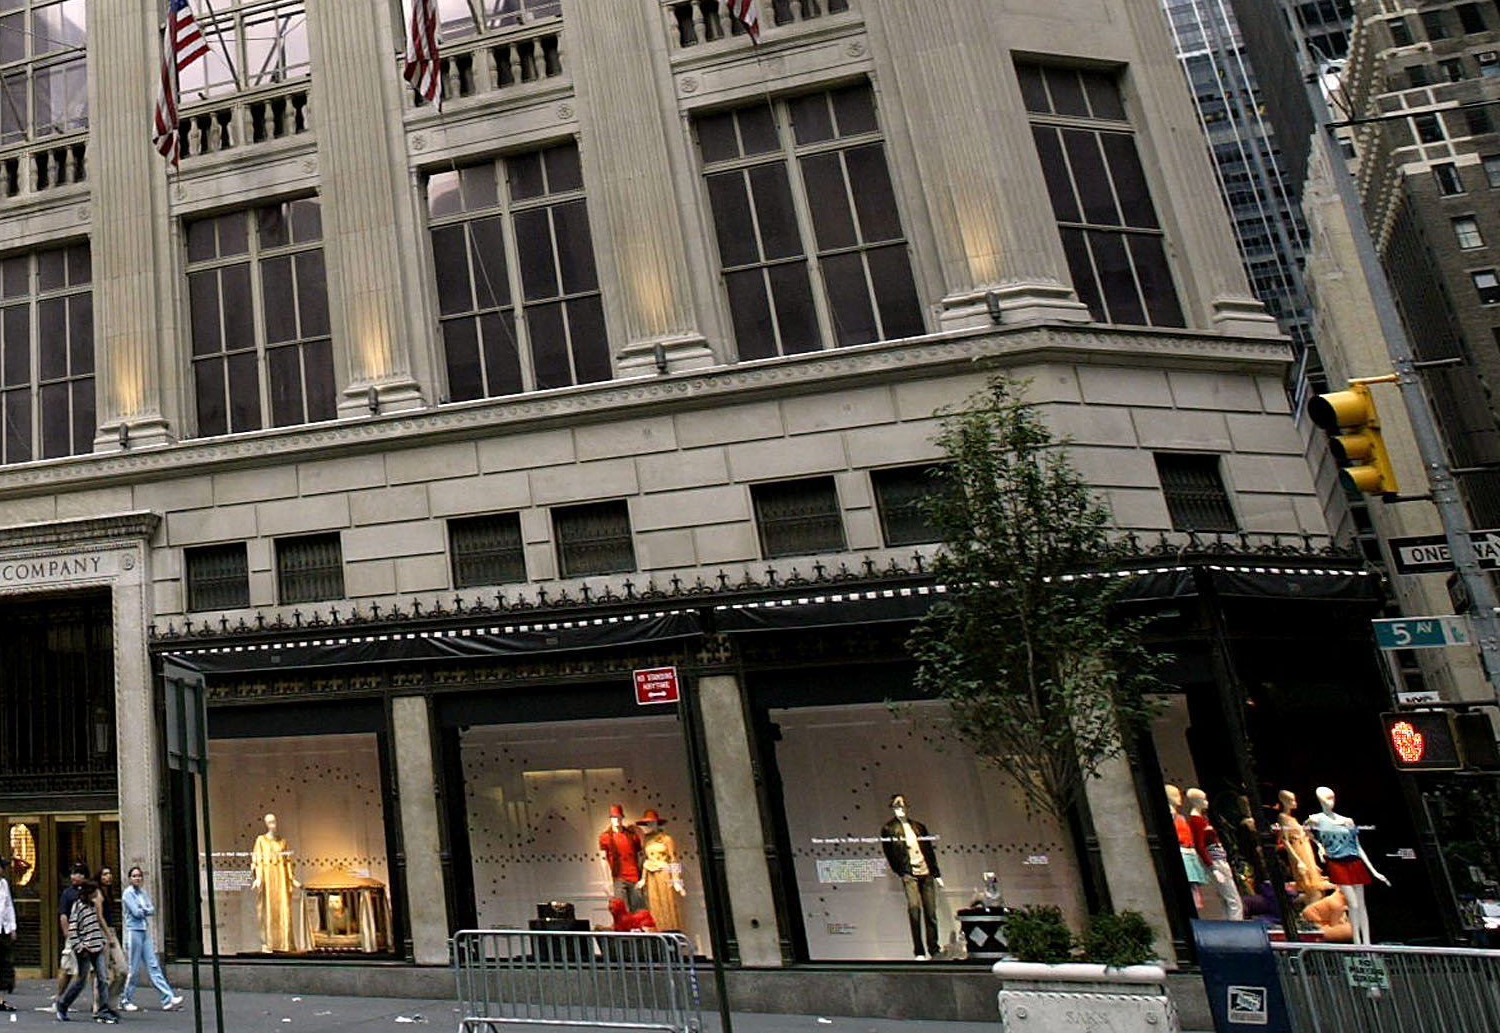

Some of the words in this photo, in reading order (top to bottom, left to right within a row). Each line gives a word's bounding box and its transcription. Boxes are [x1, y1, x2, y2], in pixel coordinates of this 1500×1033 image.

[1411, 547, 1452, 562] ONE
[2, 557, 101, 581] COMPANY
[1391, 623, 1412, 645] 5
[1416, 621, 1432, 634] AV
